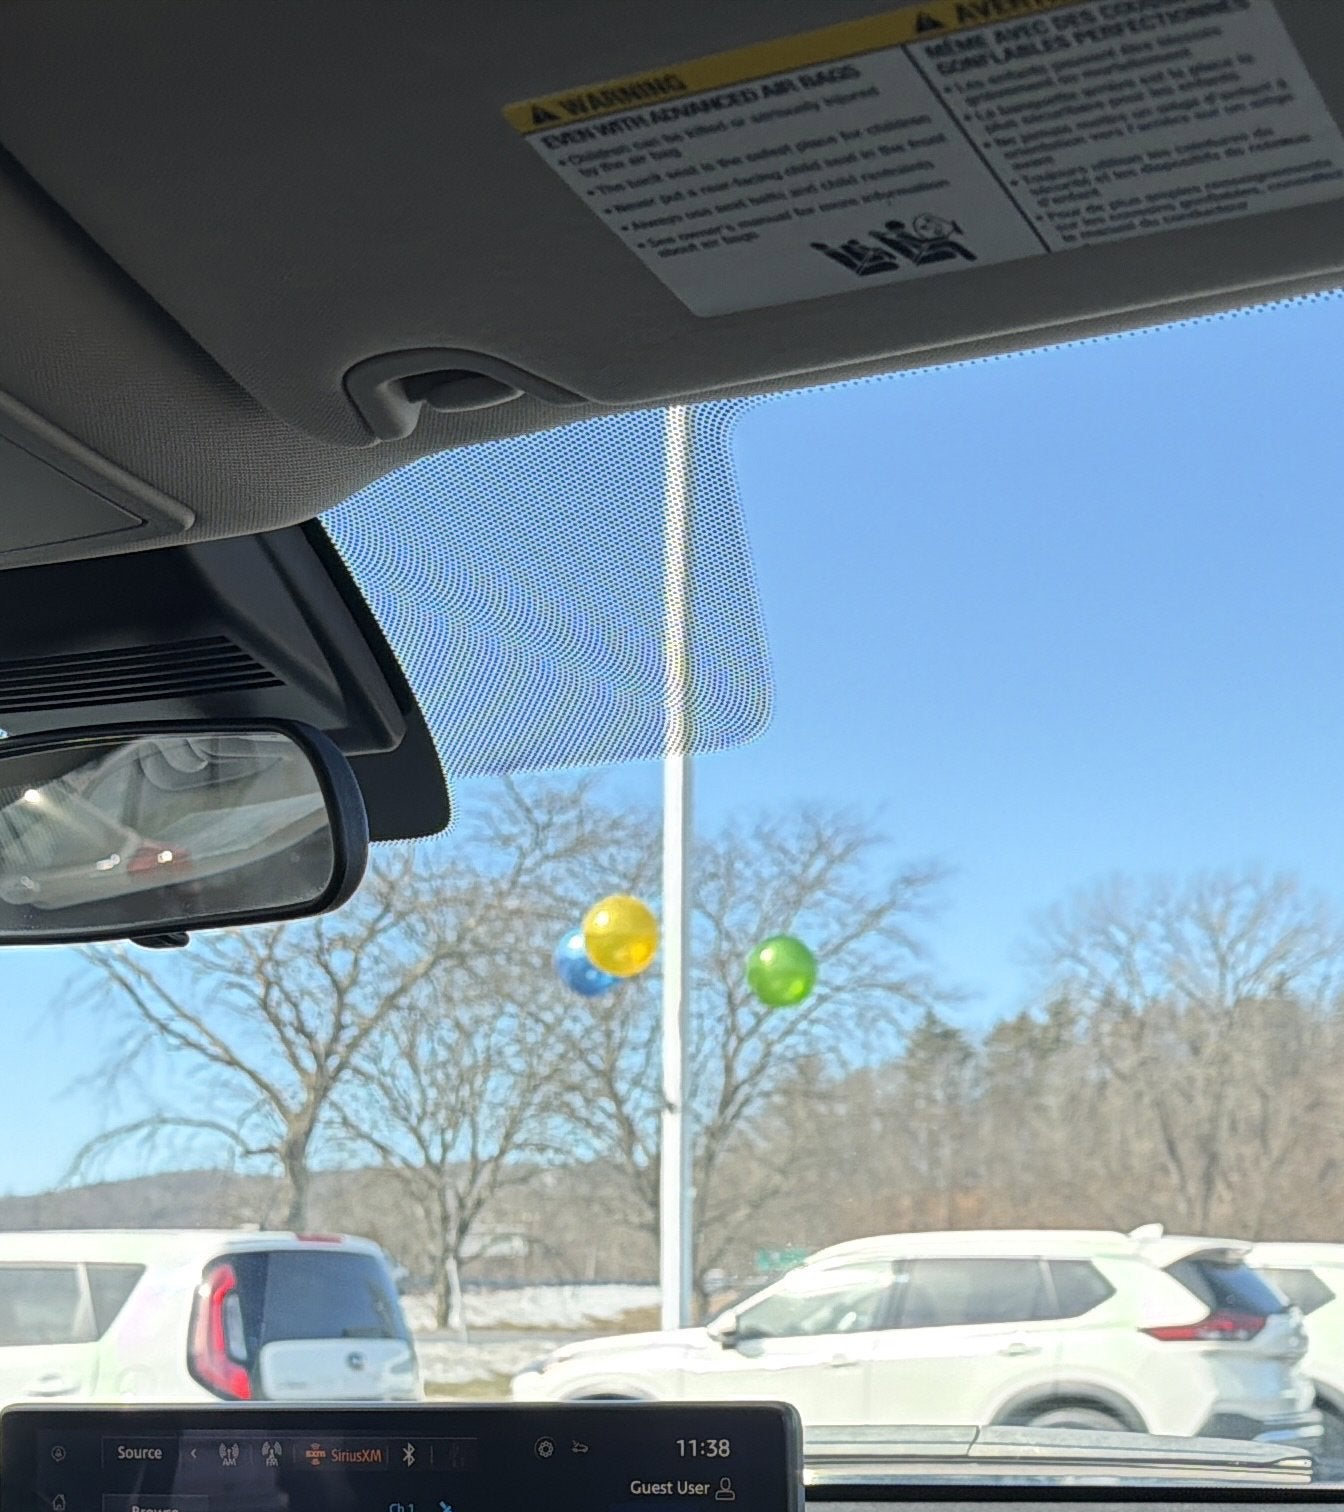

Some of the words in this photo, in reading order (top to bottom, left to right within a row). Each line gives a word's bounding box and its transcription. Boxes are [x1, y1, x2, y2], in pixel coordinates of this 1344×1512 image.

[560, 74, 686, 115] WARNING
[650, 88, 759, 123] ADVANCED
[117, 1445, 162, 1460] Source
[331, 1447, 382, 1463] SiriusXM
[676, 1439, 730, 1457] 11:38
[631, 1480, 673, 1495] Guest
[677, 1481, 710, 1496] User
